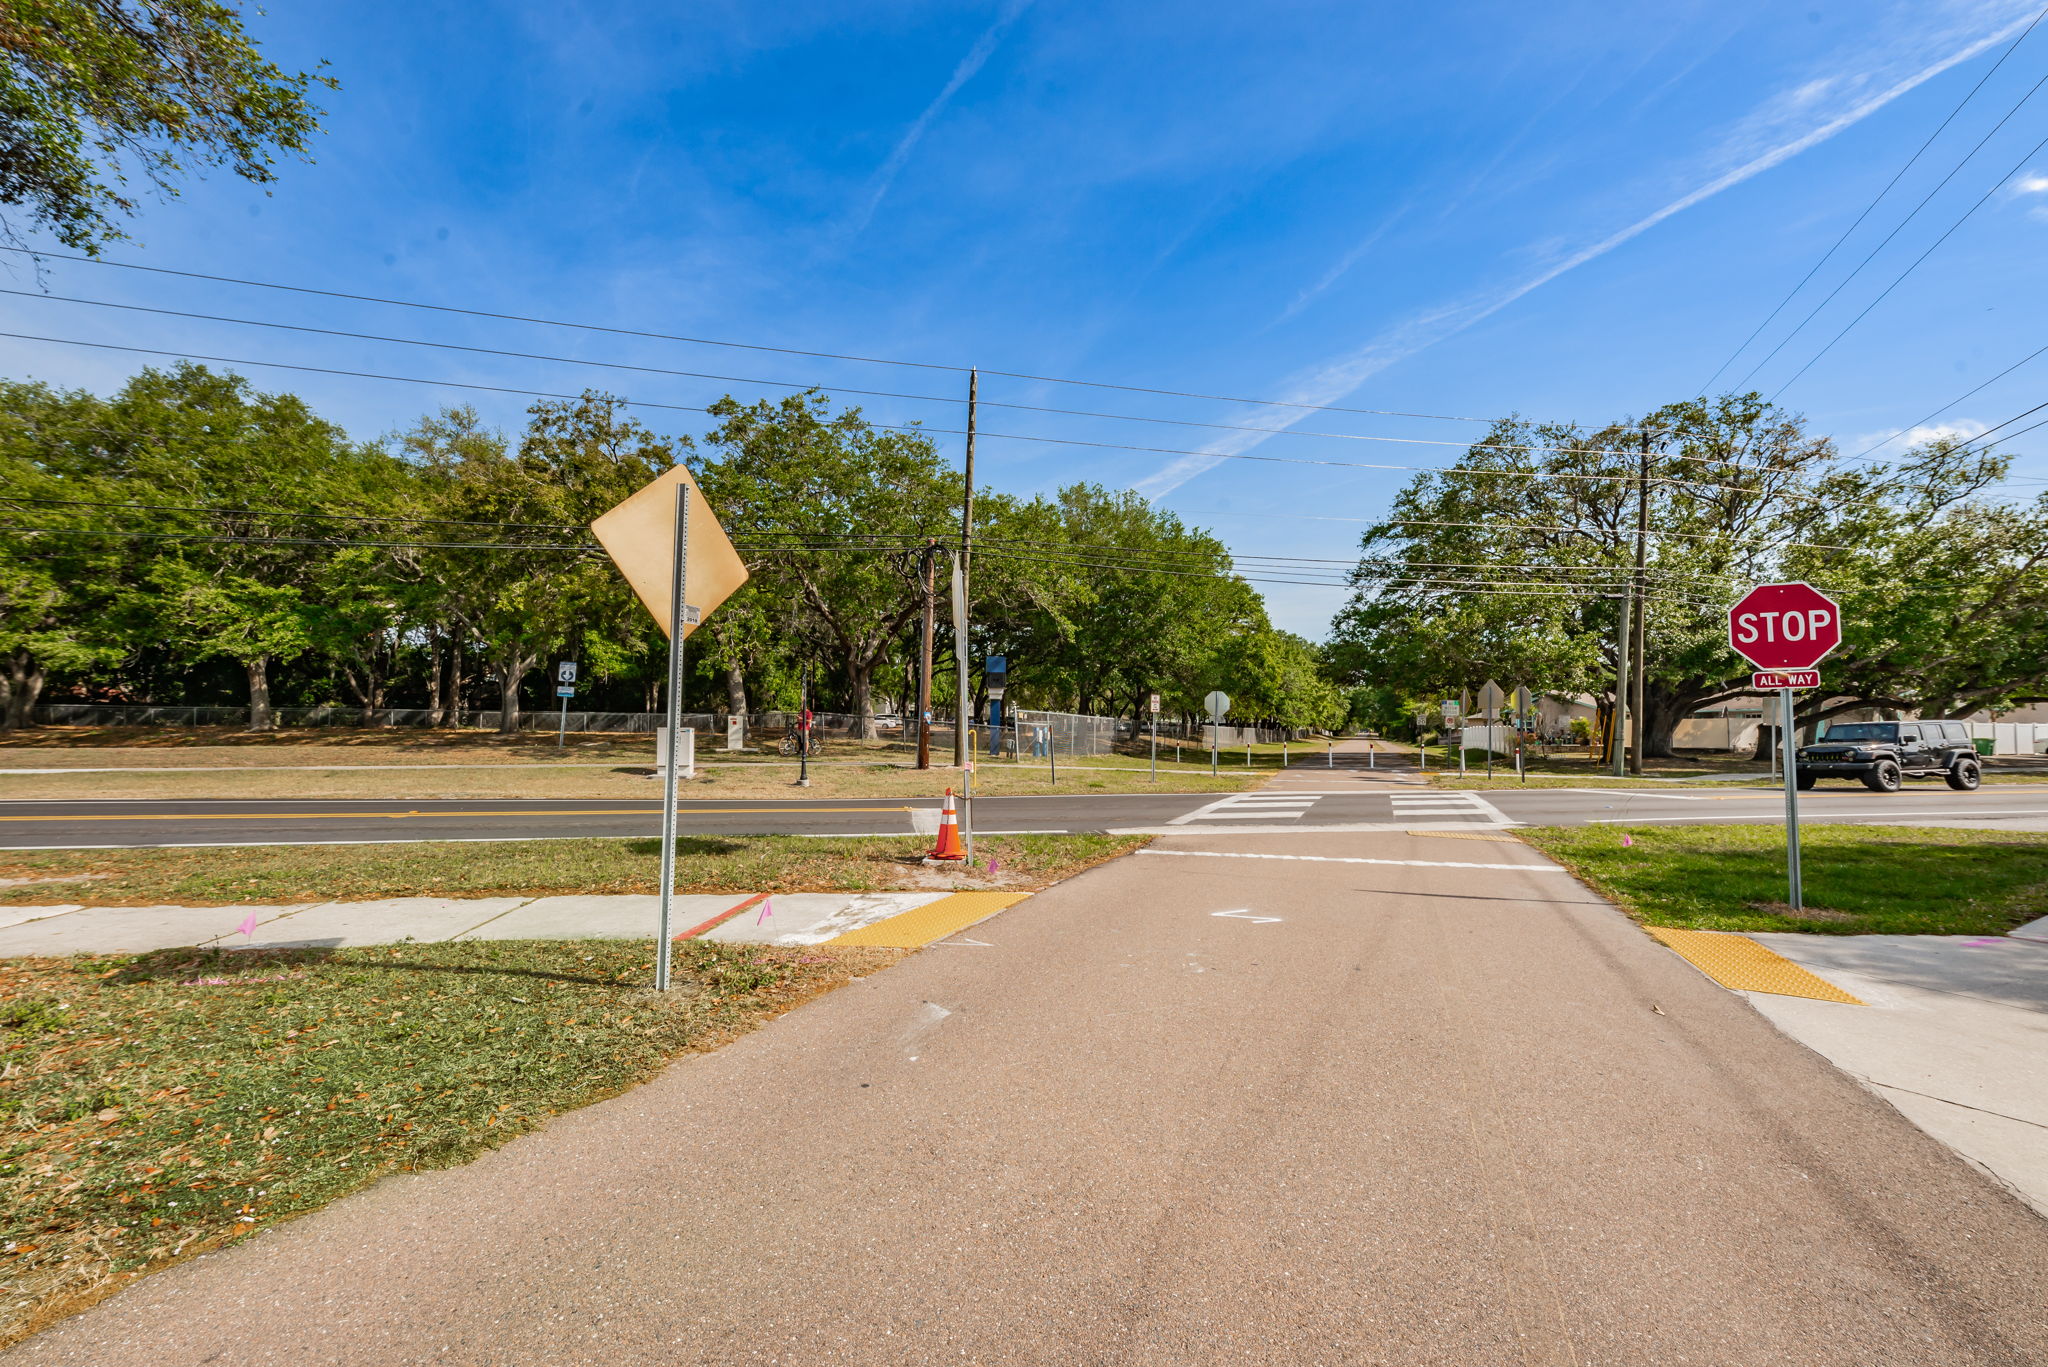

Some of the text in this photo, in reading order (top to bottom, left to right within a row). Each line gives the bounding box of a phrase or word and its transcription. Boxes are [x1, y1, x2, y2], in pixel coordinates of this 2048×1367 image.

[1737, 609, 1831, 643] STOP
[1760, 674, 1813, 686] ALL WAY
